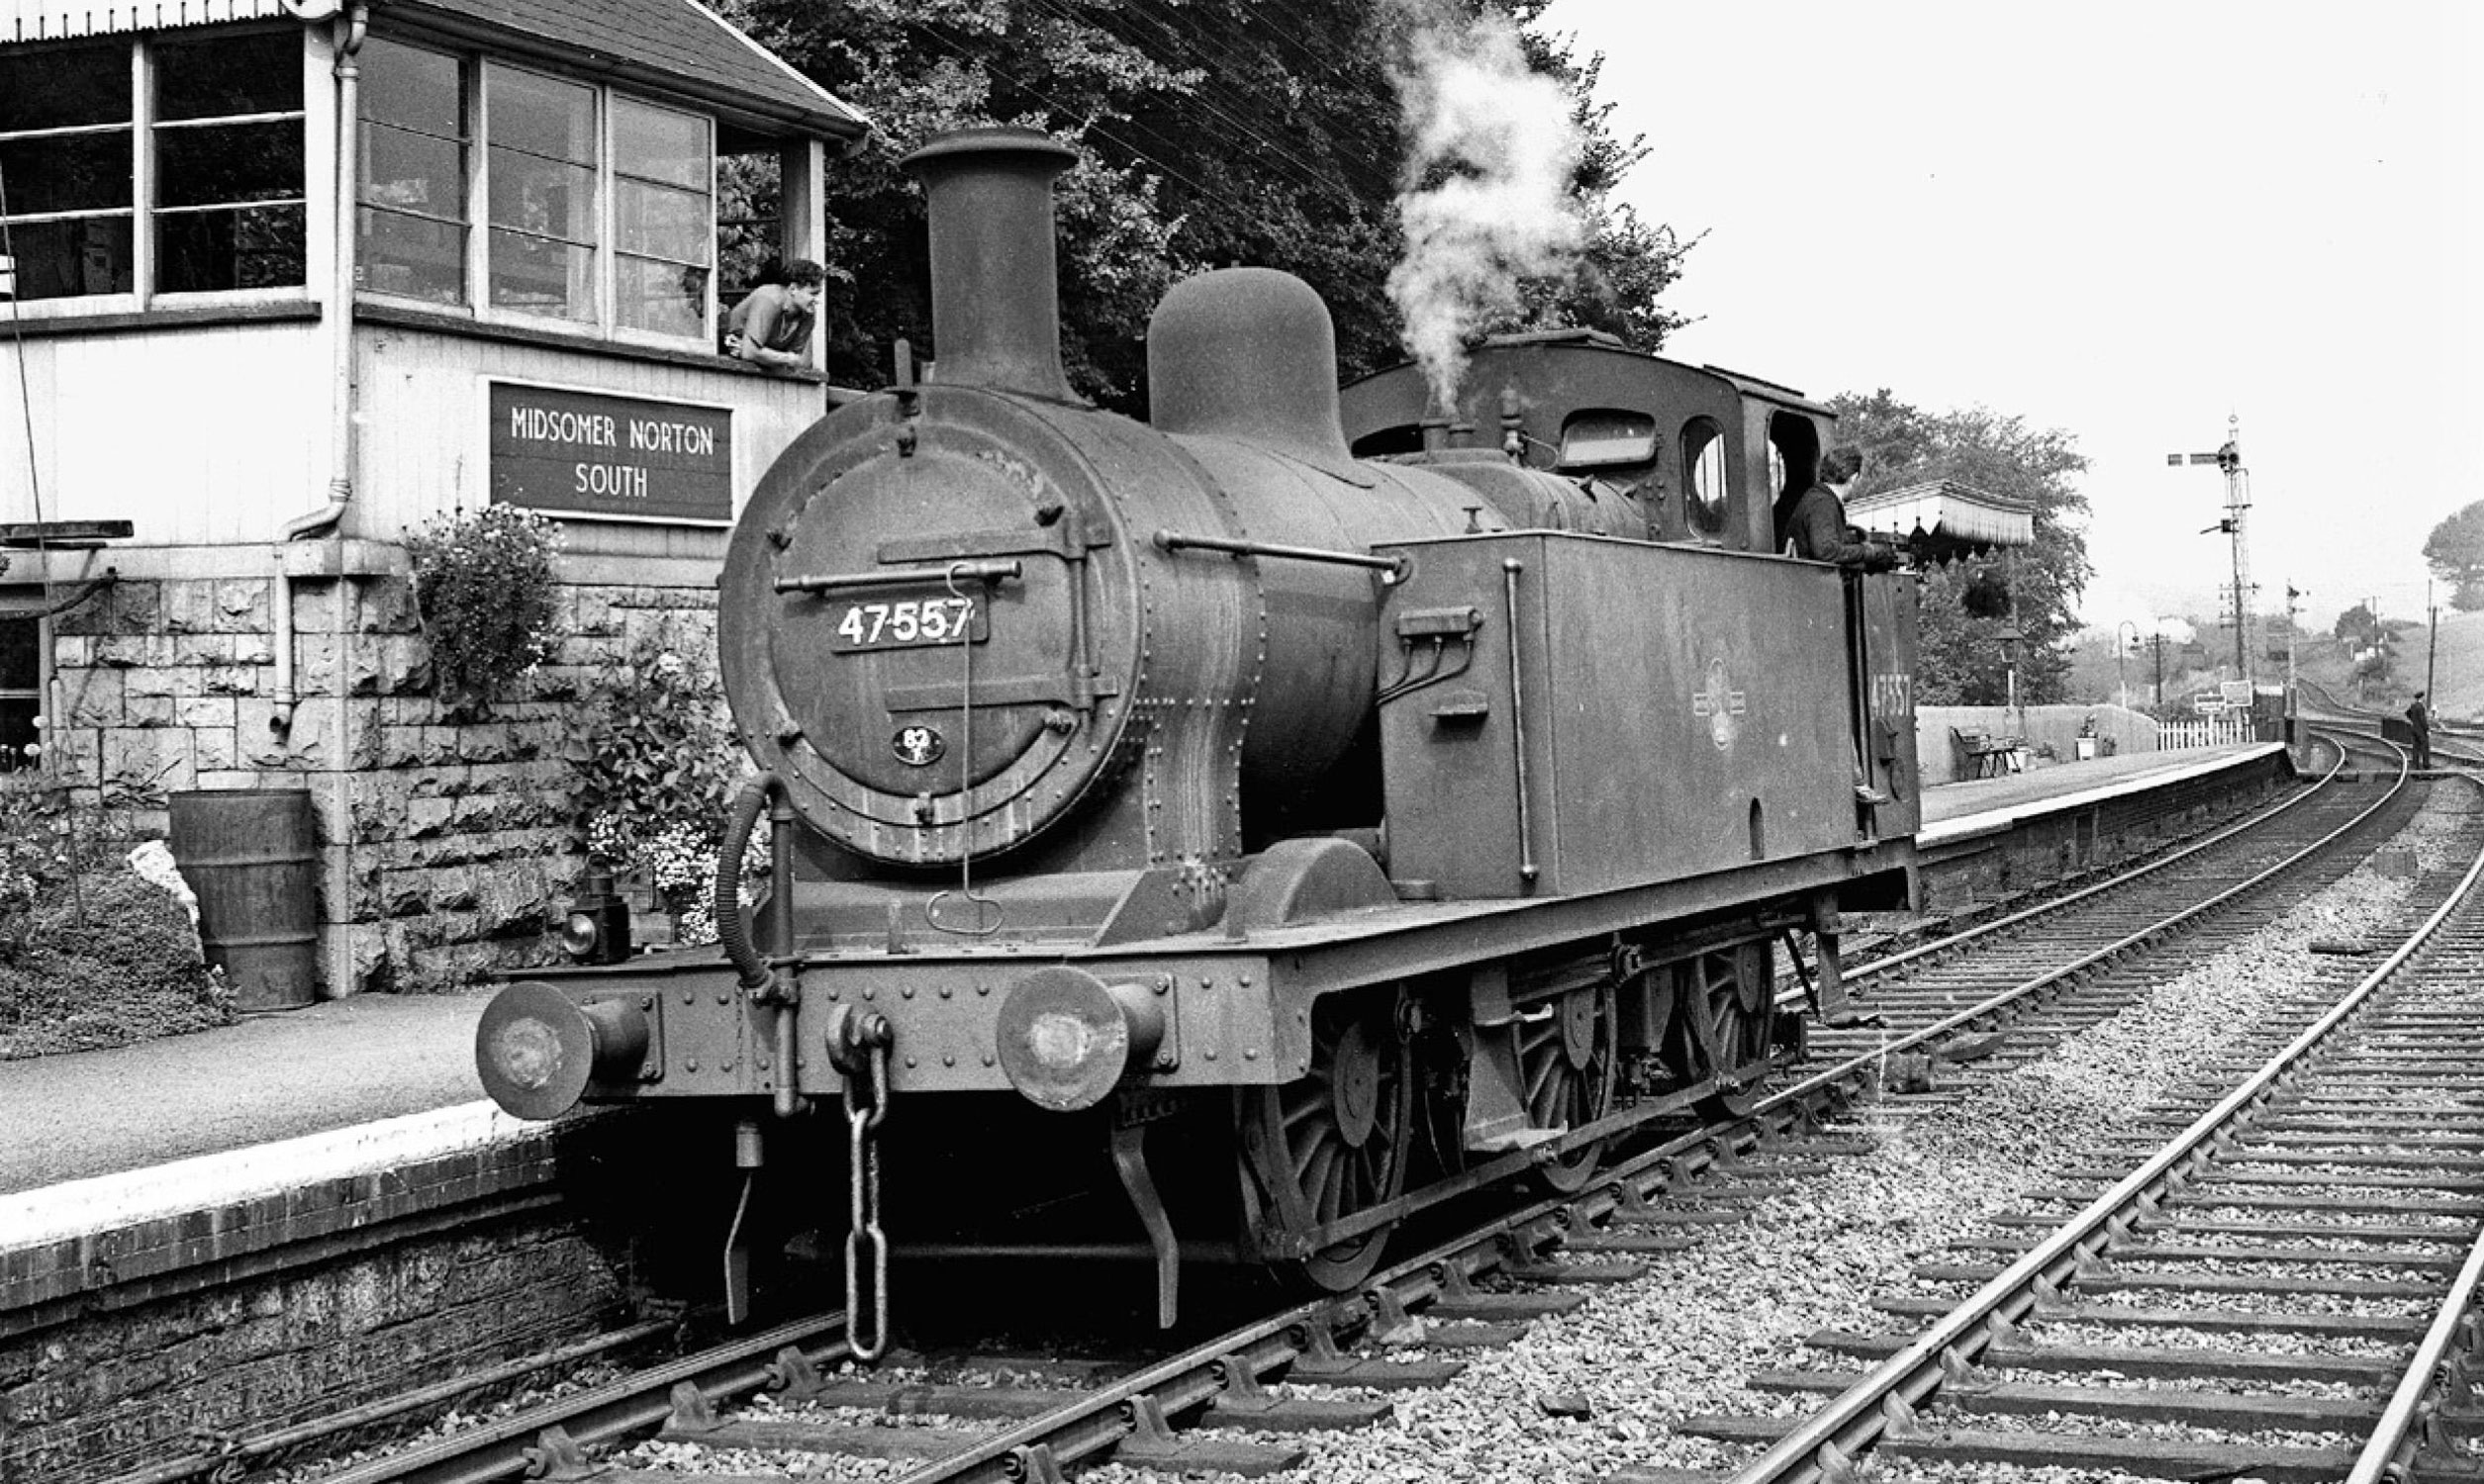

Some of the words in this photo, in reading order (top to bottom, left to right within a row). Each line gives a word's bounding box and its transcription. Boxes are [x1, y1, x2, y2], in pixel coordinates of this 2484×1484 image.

[511, 407, 617, 446] MIDSOMER
[629, 418, 714, 455] NORTON
[575, 463, 647, 497] SOUTH
[838, 598, 972, 644] 47557
[1871, 674, 1911, 717] 47557
